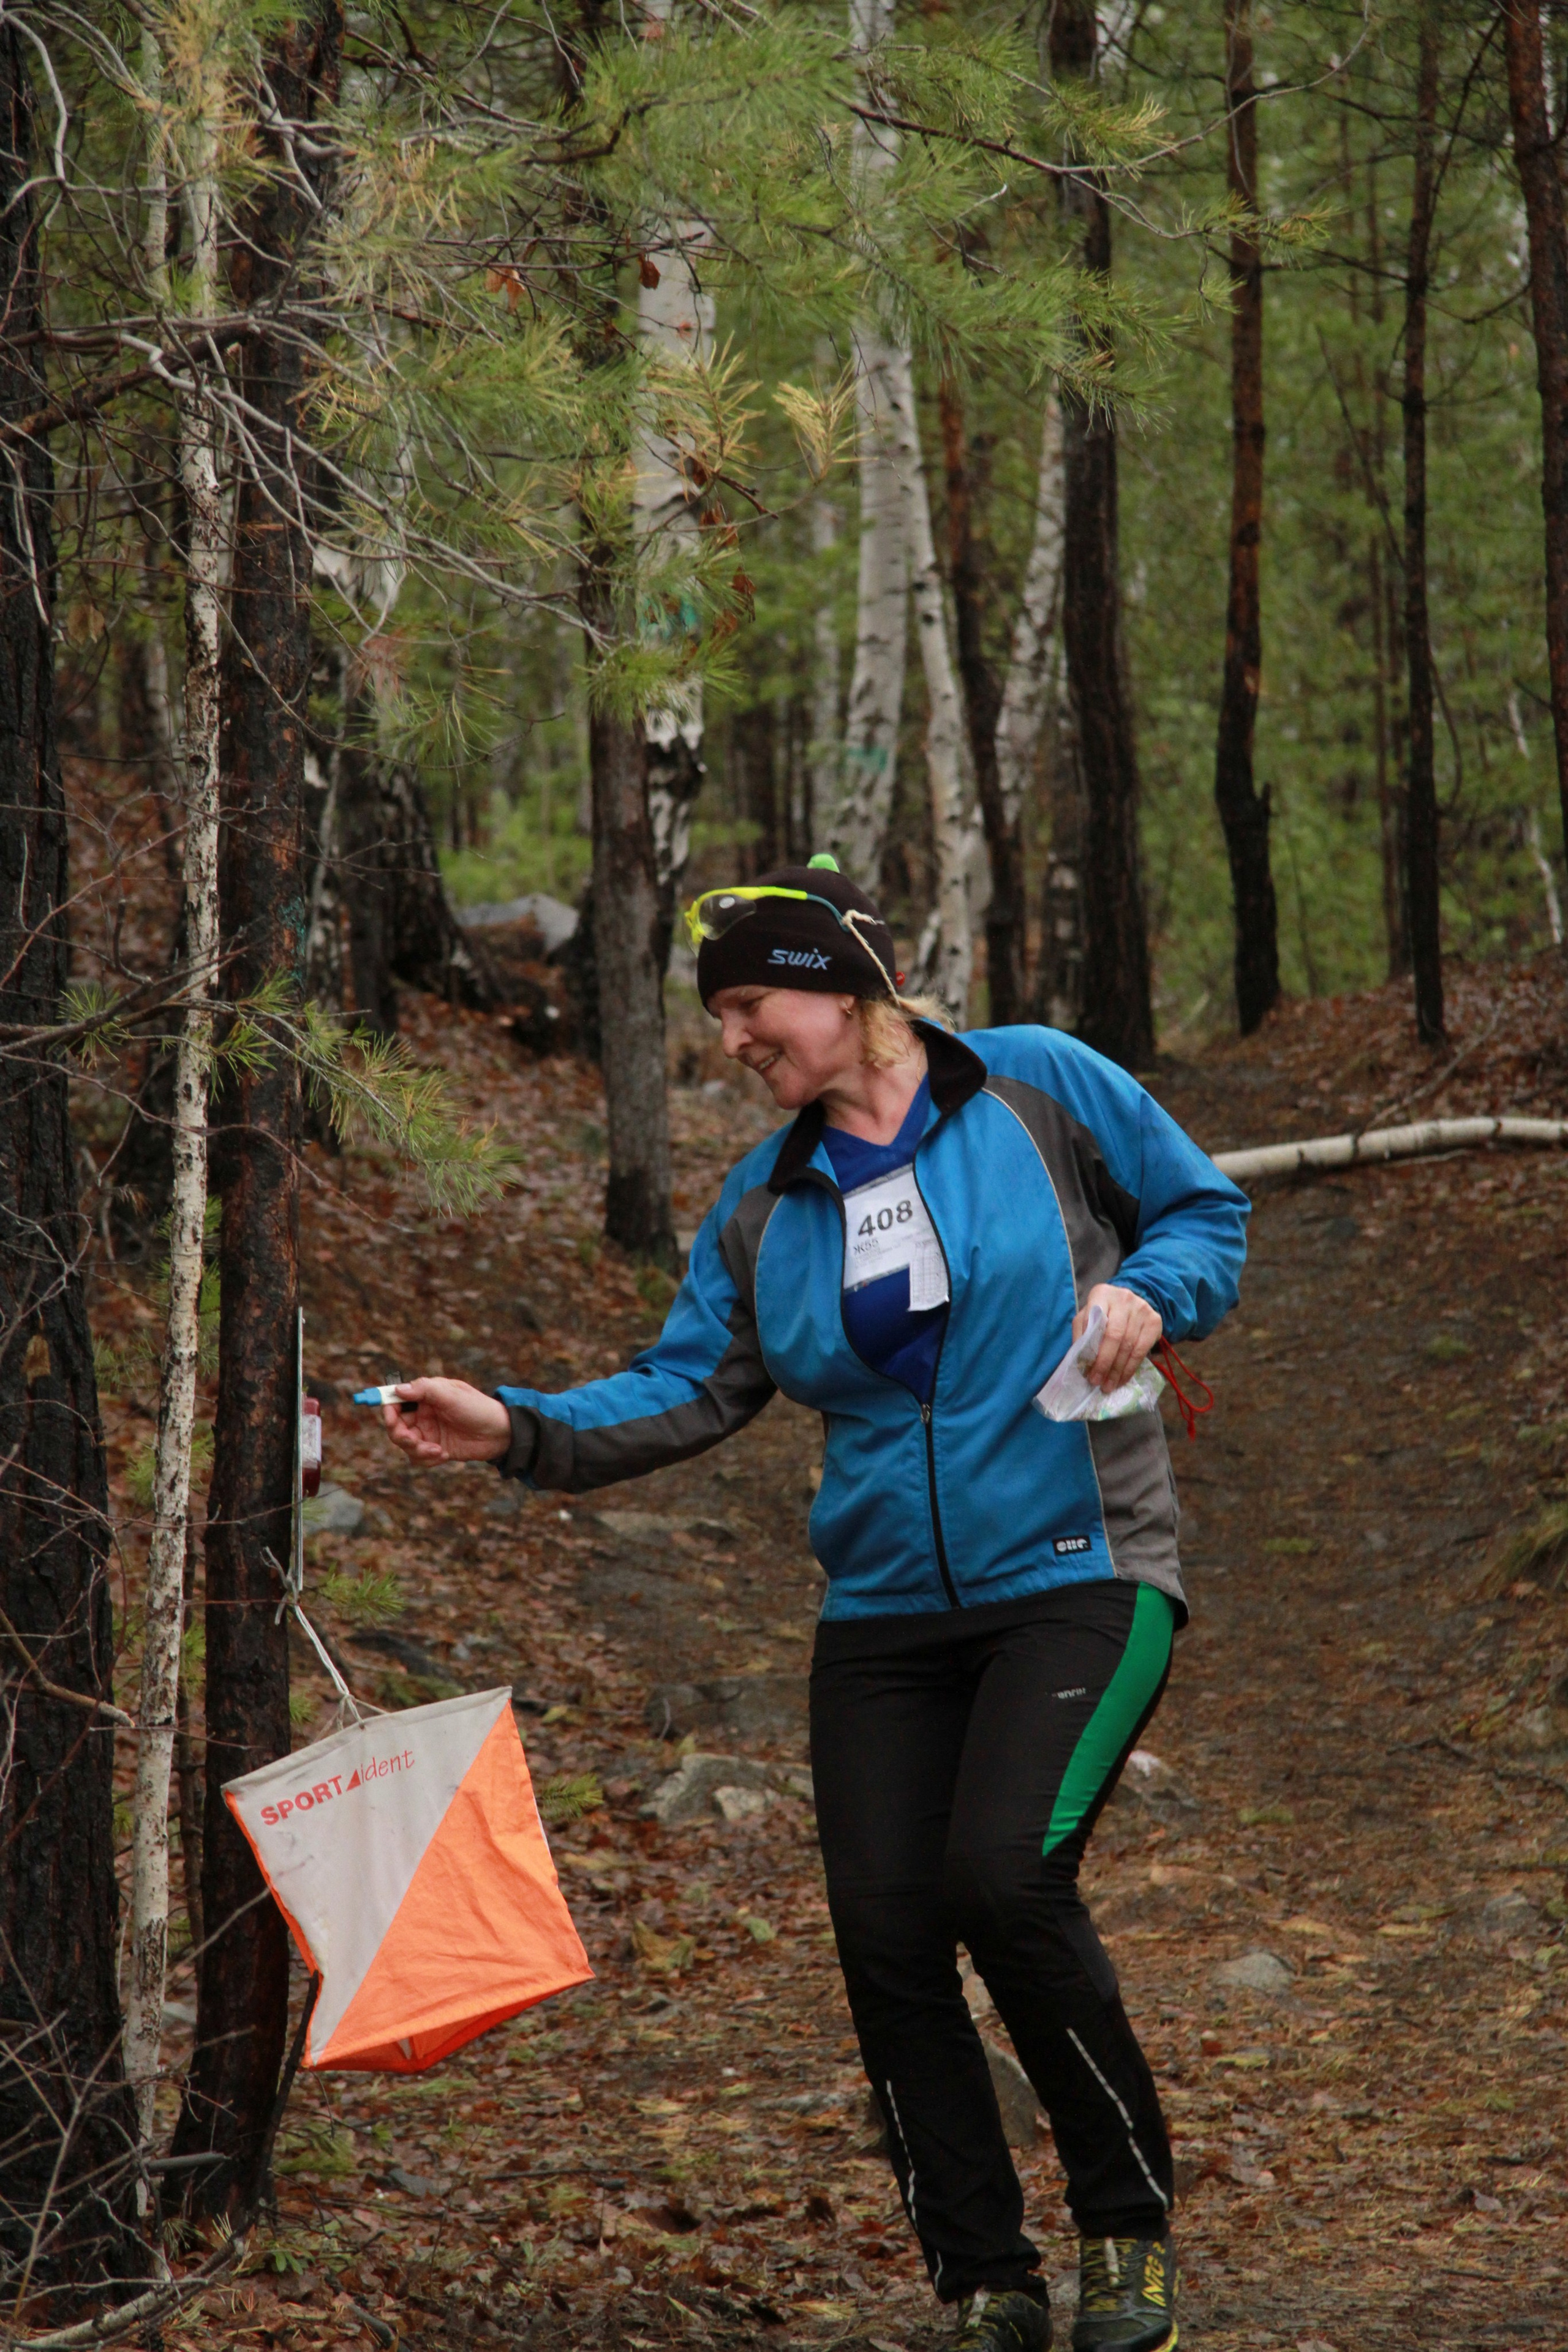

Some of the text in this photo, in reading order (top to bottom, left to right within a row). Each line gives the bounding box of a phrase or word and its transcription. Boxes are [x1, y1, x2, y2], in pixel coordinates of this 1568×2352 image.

[858, 1199, 913, 1237] 408
[260, 1749, 415, 1826] SPORT ident
